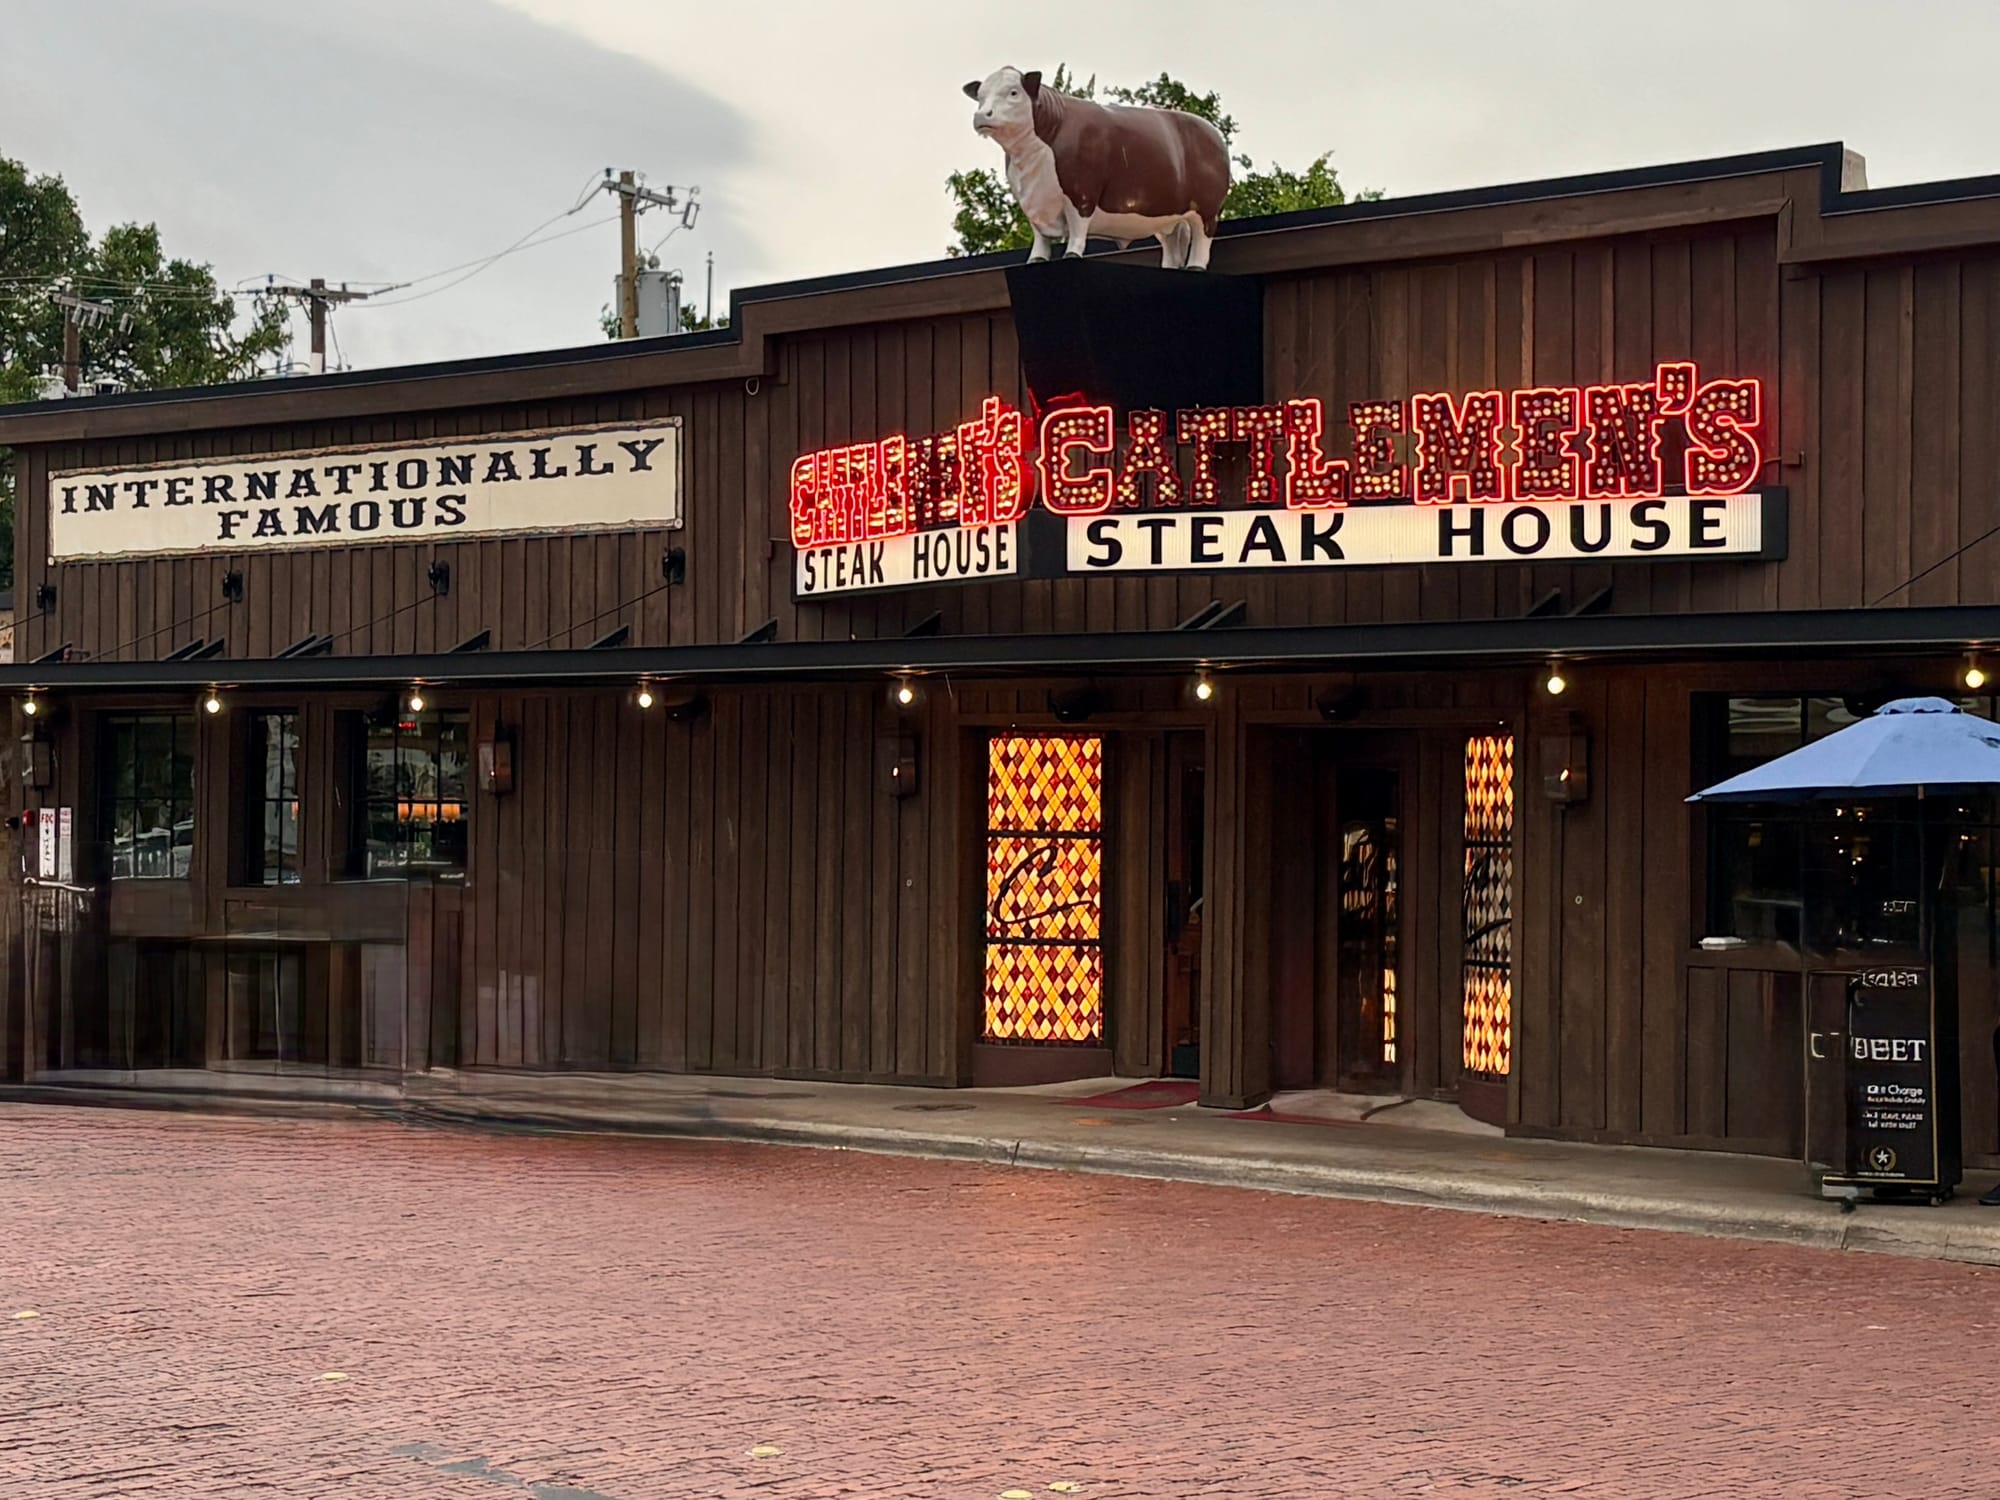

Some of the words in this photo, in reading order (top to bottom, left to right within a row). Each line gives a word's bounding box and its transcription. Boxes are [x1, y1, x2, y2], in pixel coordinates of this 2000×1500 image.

[1036, 362, 1761, 515] CATTLEMEN'S
[61, 438, 665, 513] INTERNATIONALLY
[217, 494, 468, 540] FAMOUS
[1086, 511, 1345, 567] STEAK
[1438, 499, 1728, 557] HOUSE
[804, 539, 885, 592] STEAK
[913, 523, 1010, 580] HOUSE
